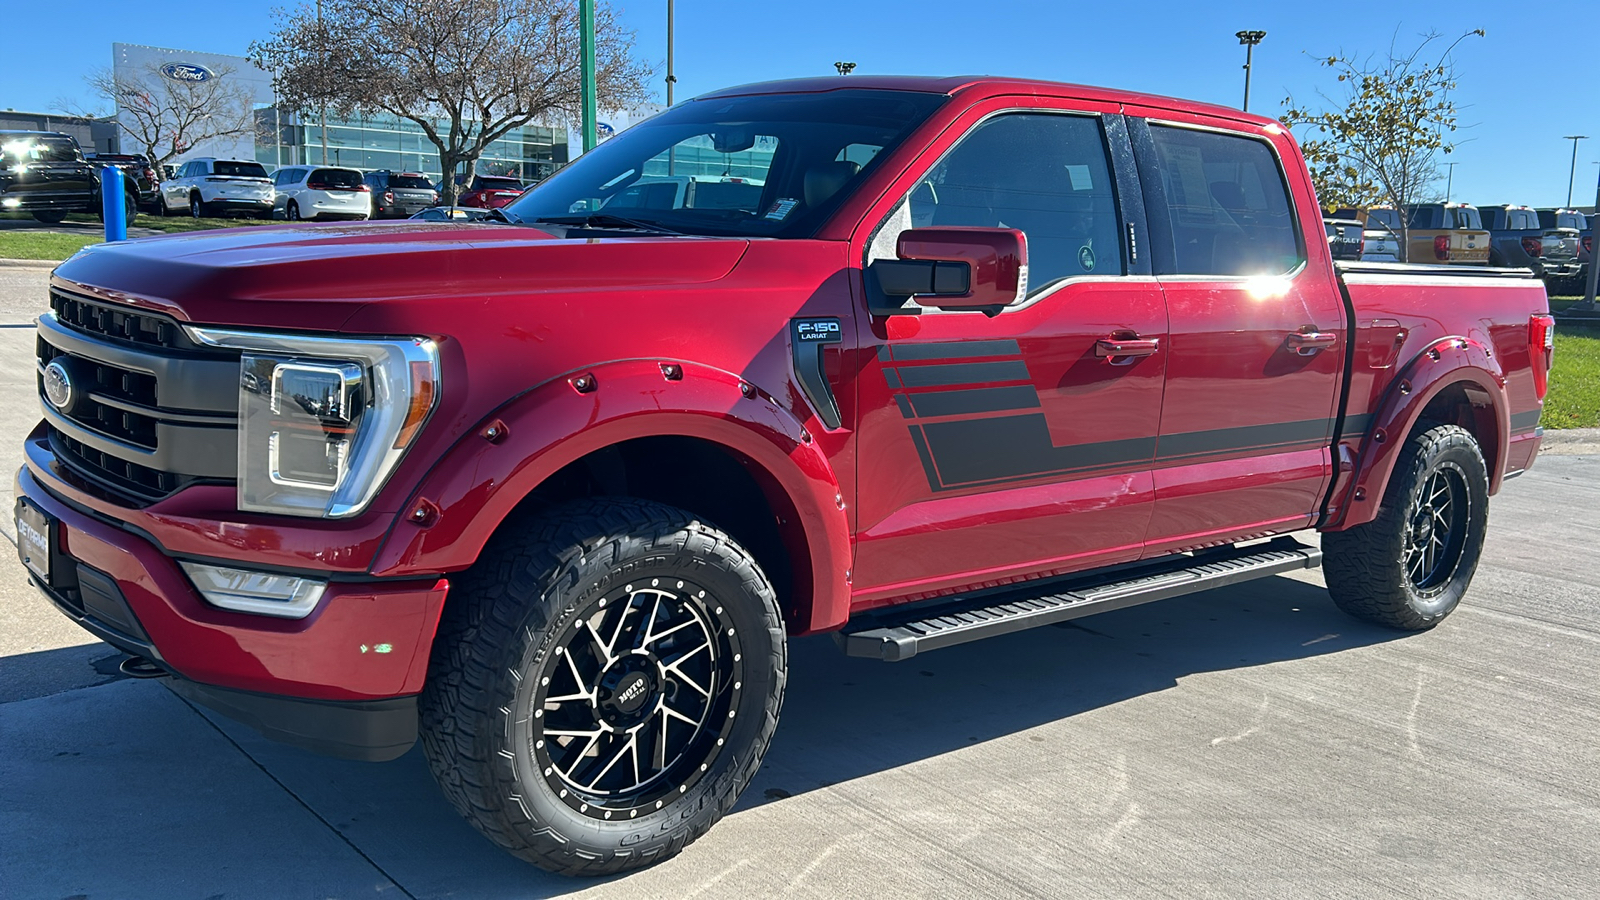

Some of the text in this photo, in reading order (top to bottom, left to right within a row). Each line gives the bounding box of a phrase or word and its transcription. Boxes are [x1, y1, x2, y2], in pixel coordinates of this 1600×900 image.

[173, 66, 204, 80] Ford
[798, 322, 839, 332] F-150
[618, 678, 644, 704] MOTO
[629, 686, 646, 701] METAL
